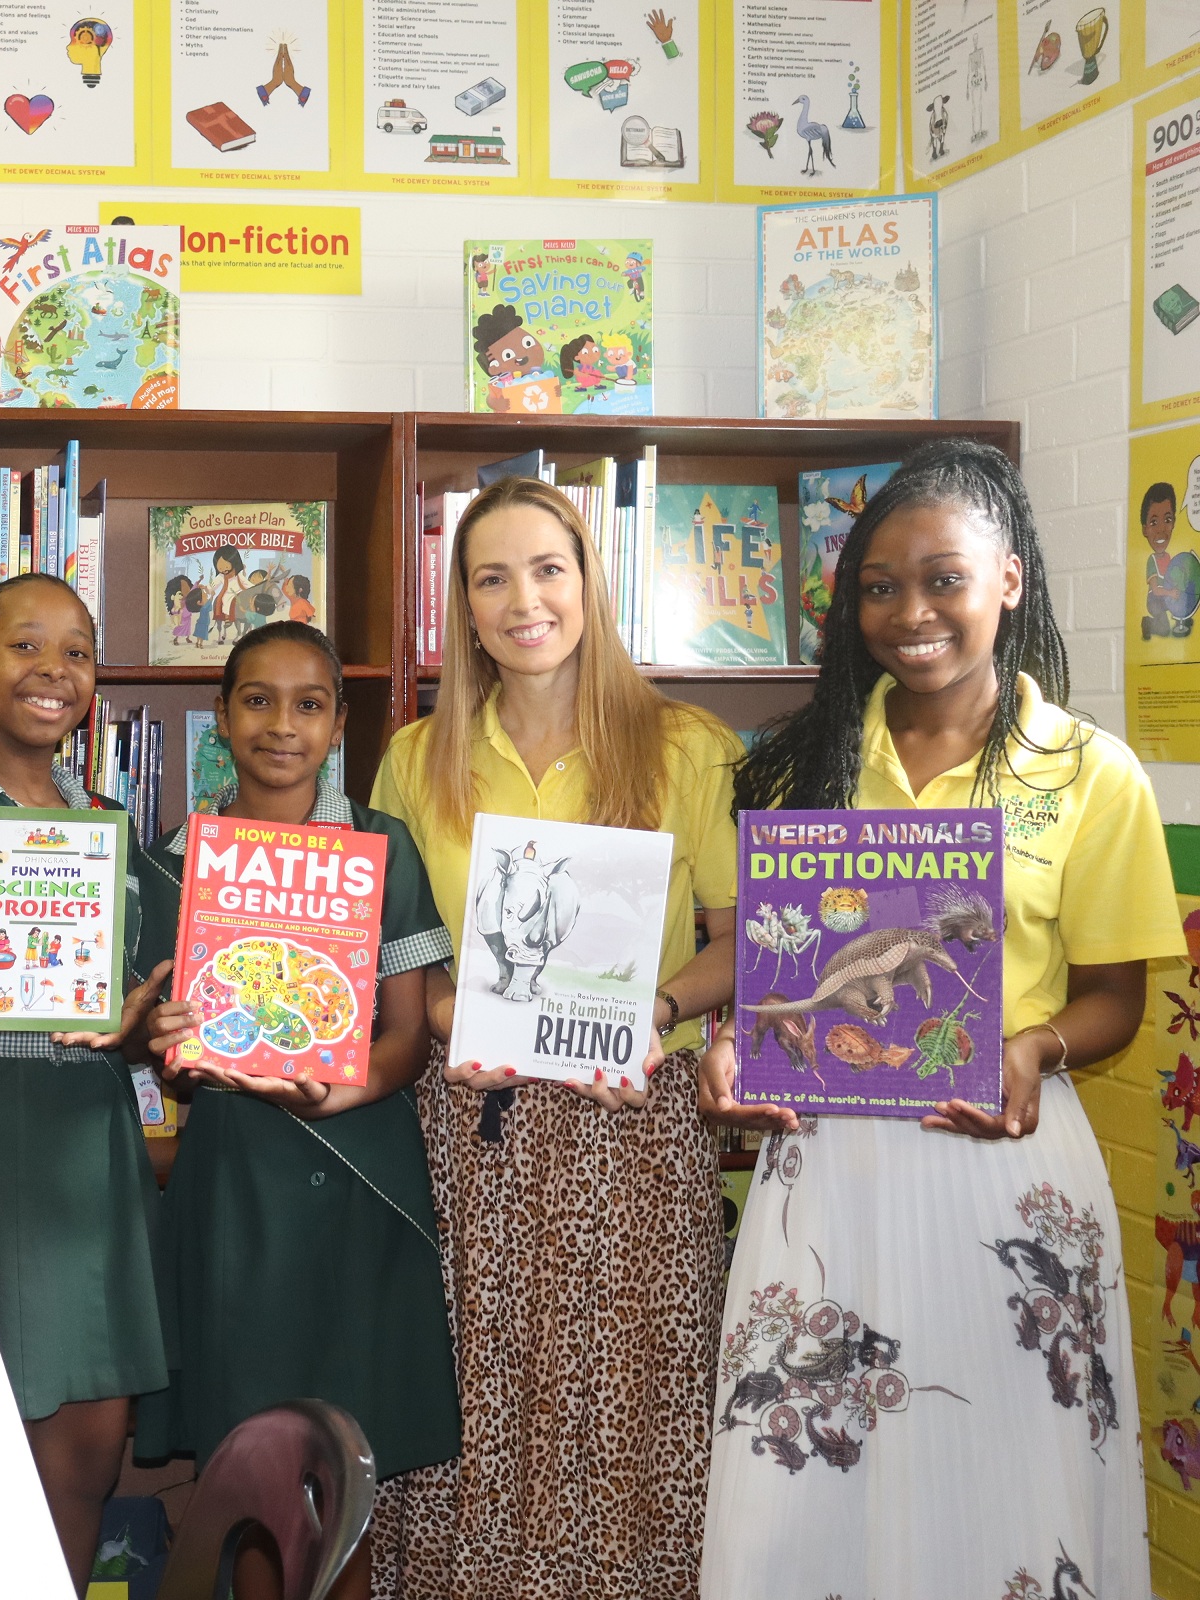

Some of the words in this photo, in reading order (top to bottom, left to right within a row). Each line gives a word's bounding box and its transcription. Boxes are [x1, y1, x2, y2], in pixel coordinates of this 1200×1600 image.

[610, 65, 628, 74] HELLO
[1154, 114, 1193, 153] 900
[811, 212, 855, 222] CHILDREN'S
[859, 209, 898, 218] PICTORIAL
[796, 222, 898, 250] ATLAS
[82, 237, 173, 278] Atlas
[503, 255, 542, 275] First
[586, 257, 603, 267] Can
[607, 261, 620, 272] Do
[794, 252, 812, 262] OF
[818, 250, 843, 260] THE
[849, 245, 900, 258] WORLD
[498, 269, 591, 303] Saving
[596, 277, 624, 292] Our
[524, 294, 612, 325] planet
[0, 474, 9, 512] Read-Together
[189, 514, 221, 529] God's
[223, 512, 256, 525] Great
[259, 512, 285, 526] Plan
[182, 532, 255, 552] STORYBOOK
[261, 534, 295, 548] BIBLE
[79, 544, 89, 596] BIBLE
[1004, 805, 1059, 824] LEARN
[1018, 818, 1046, 828] Project
[203, 826, 216, 835] DK
[235, 828, 276, 844] HOW
[280, 833, 302, 846] TO
[307, 836, 327, 849] BE
[332, 838, 344, 851] A
[751, 824, 848, 846] WEIRD
[857, 822, 993, 845] ANIMALS
[12, 866, 39, 876] FUN
[44, 867, 80, 877] WITH
[197, 841, 374, 896] MATHS
[750, 852, 994, 880] DICTIONARY
[218, 886, 348, 921] GENIUS
[221, 918, 259, 926] BRILLIANT
[541, 997, 563, 1013] The
[570, 1001, 636, 1026] Rumbling
[534, 1015, 632, 1065] RHINO
[744, 1092, 757, 1100] An
[794, 1094, 806, 1102] of
[808, 1094, 825, 1103] the
[828, 1096, 866, 1104] world's
